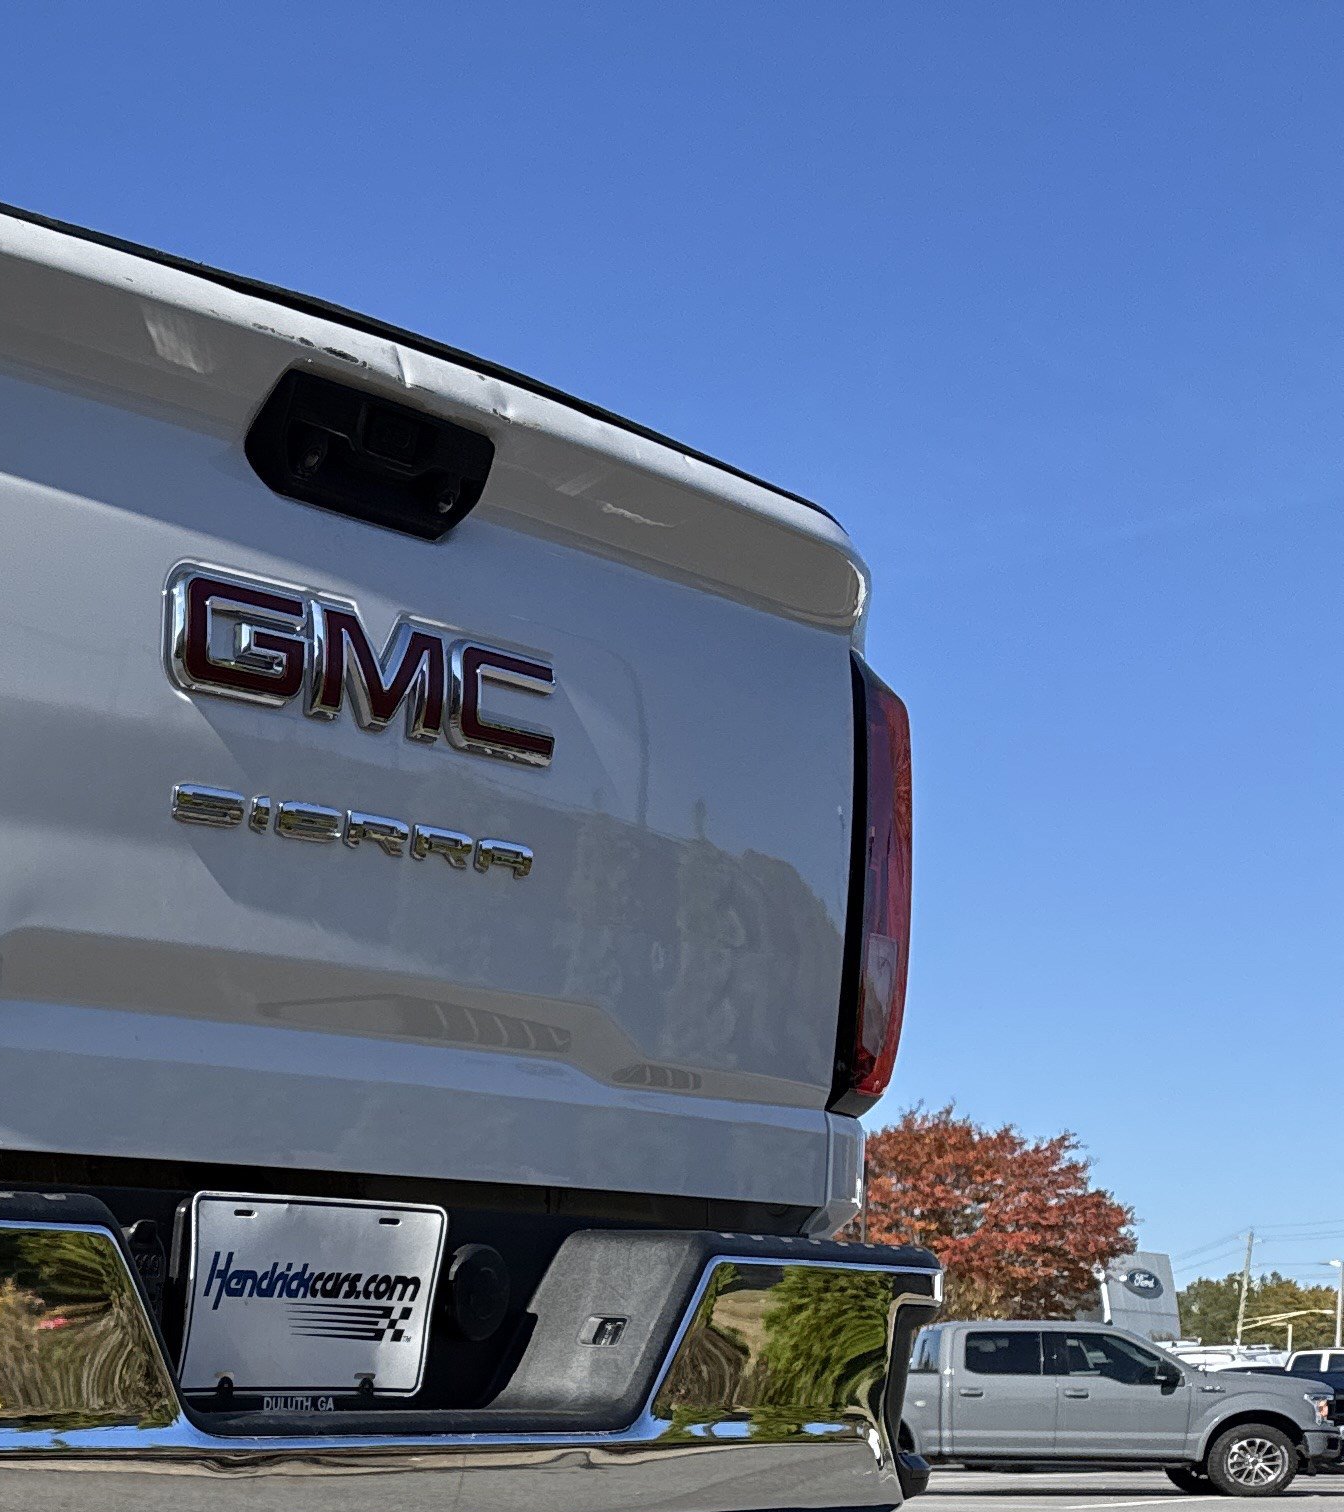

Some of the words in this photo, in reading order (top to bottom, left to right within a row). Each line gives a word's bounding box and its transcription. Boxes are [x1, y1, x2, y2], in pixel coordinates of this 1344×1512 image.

[162, 558, 557, 767] GMC
[172, 783, 534, 880] SIERRA
[203, 1251, 421, 1310] Hendrickcars.com
[317, 1396, 334, 1411] GA
